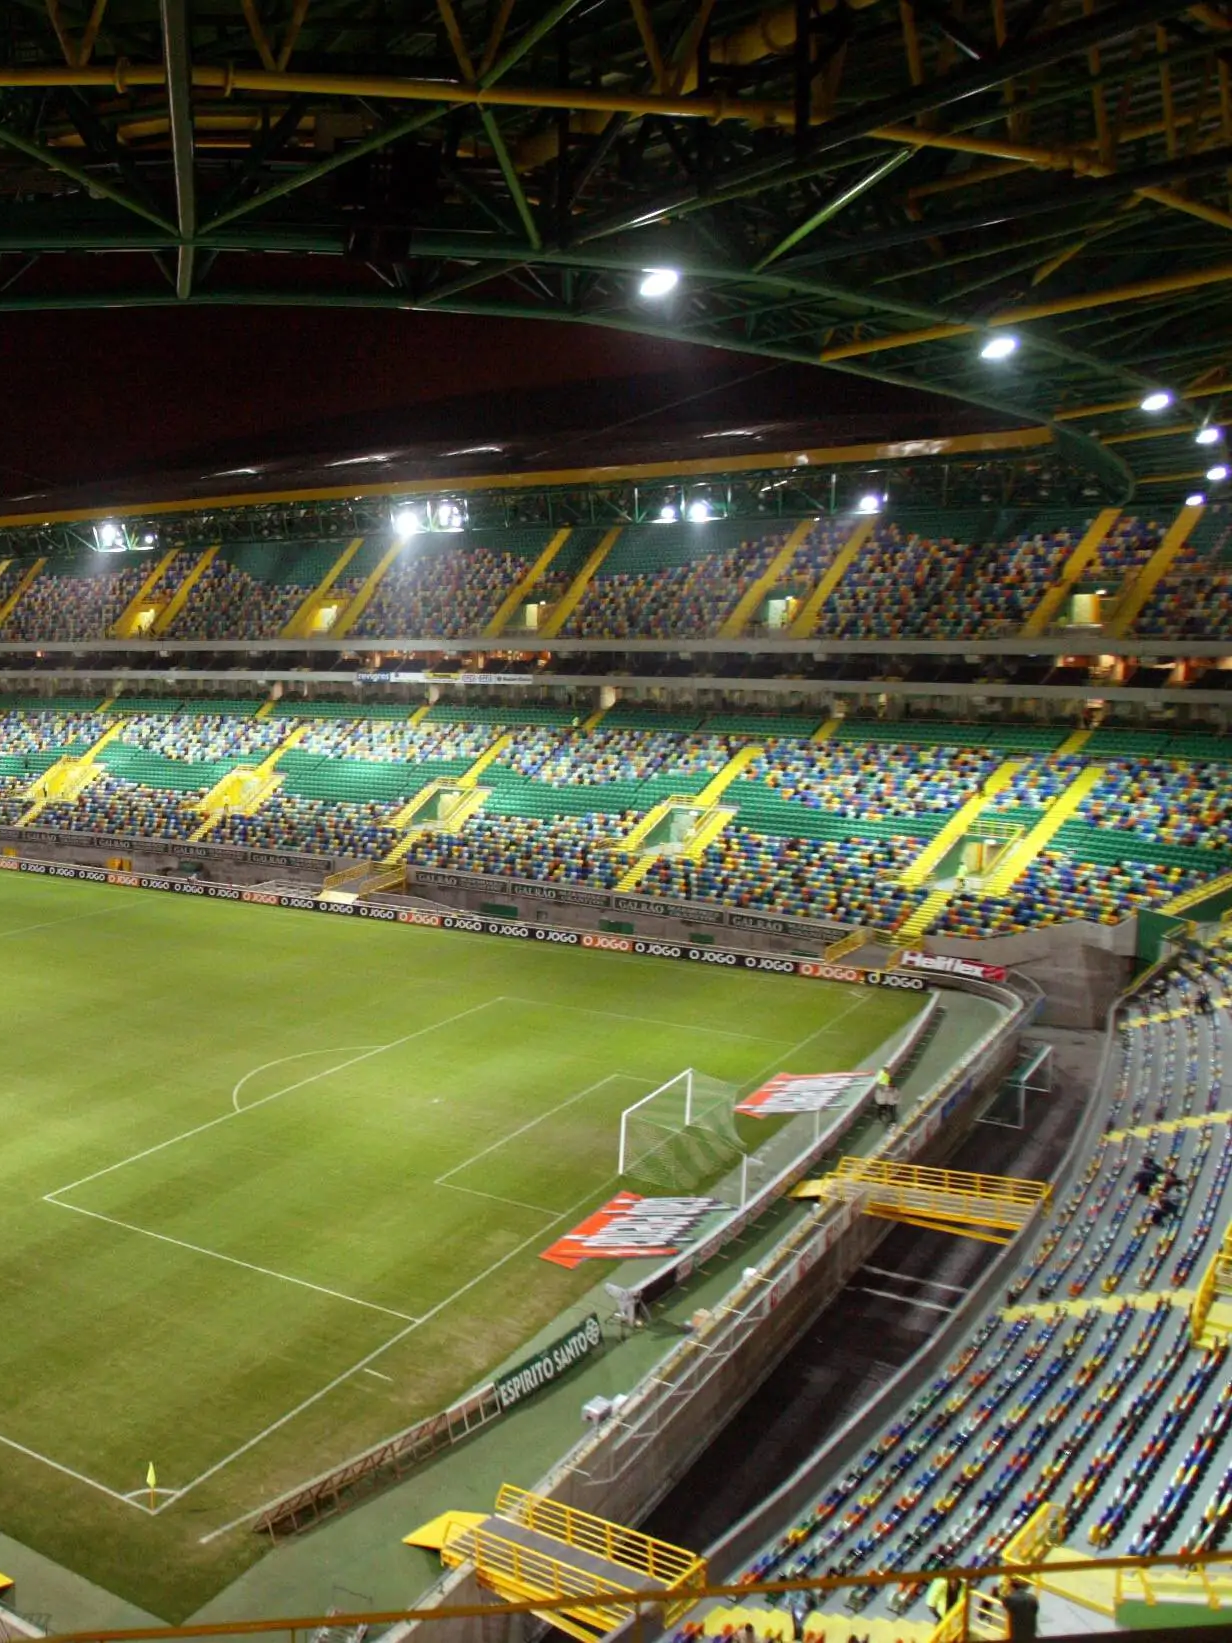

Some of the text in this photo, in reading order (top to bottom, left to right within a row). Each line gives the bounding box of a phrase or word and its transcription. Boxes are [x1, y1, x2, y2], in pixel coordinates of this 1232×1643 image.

[0, 860, 17, 869] JOGO
[56, 868, 75, 877] JOGO
[86, 872, 105, 881] JOGO
[117, 876, 138, 886] JOGO
[149, 880, 169, 890] JOGO
[174, 883, 204, 894] O JOGO
[209, 887, 238, 899] O JOGO
[243, 892, 276, 903] O JOGO
[281, 897, 314, 908] O JOGO
[320, 902, 353, 914] O JOGO
[360, 907, 394, 920] O JOGO
[399, 912, 438, 925] O JOGO
[444, 918, 481, 930] O JOGO
[489, 924, 528, 937] O JOGO
[536, 930, 577, 944] O JOGO
[583, 936, 629, 950] O JOGO
[635, 943, 681, 957] O JOGO
[689, 950, 736, 964] O JOGO
[745, 957, 794, 972] O JOGO
[801, 964, 856, 981] O JOGO
[868, 973, 923, 990] O JOGO
[500, 1332, 588, 1406] ESPIRITO SANTO
